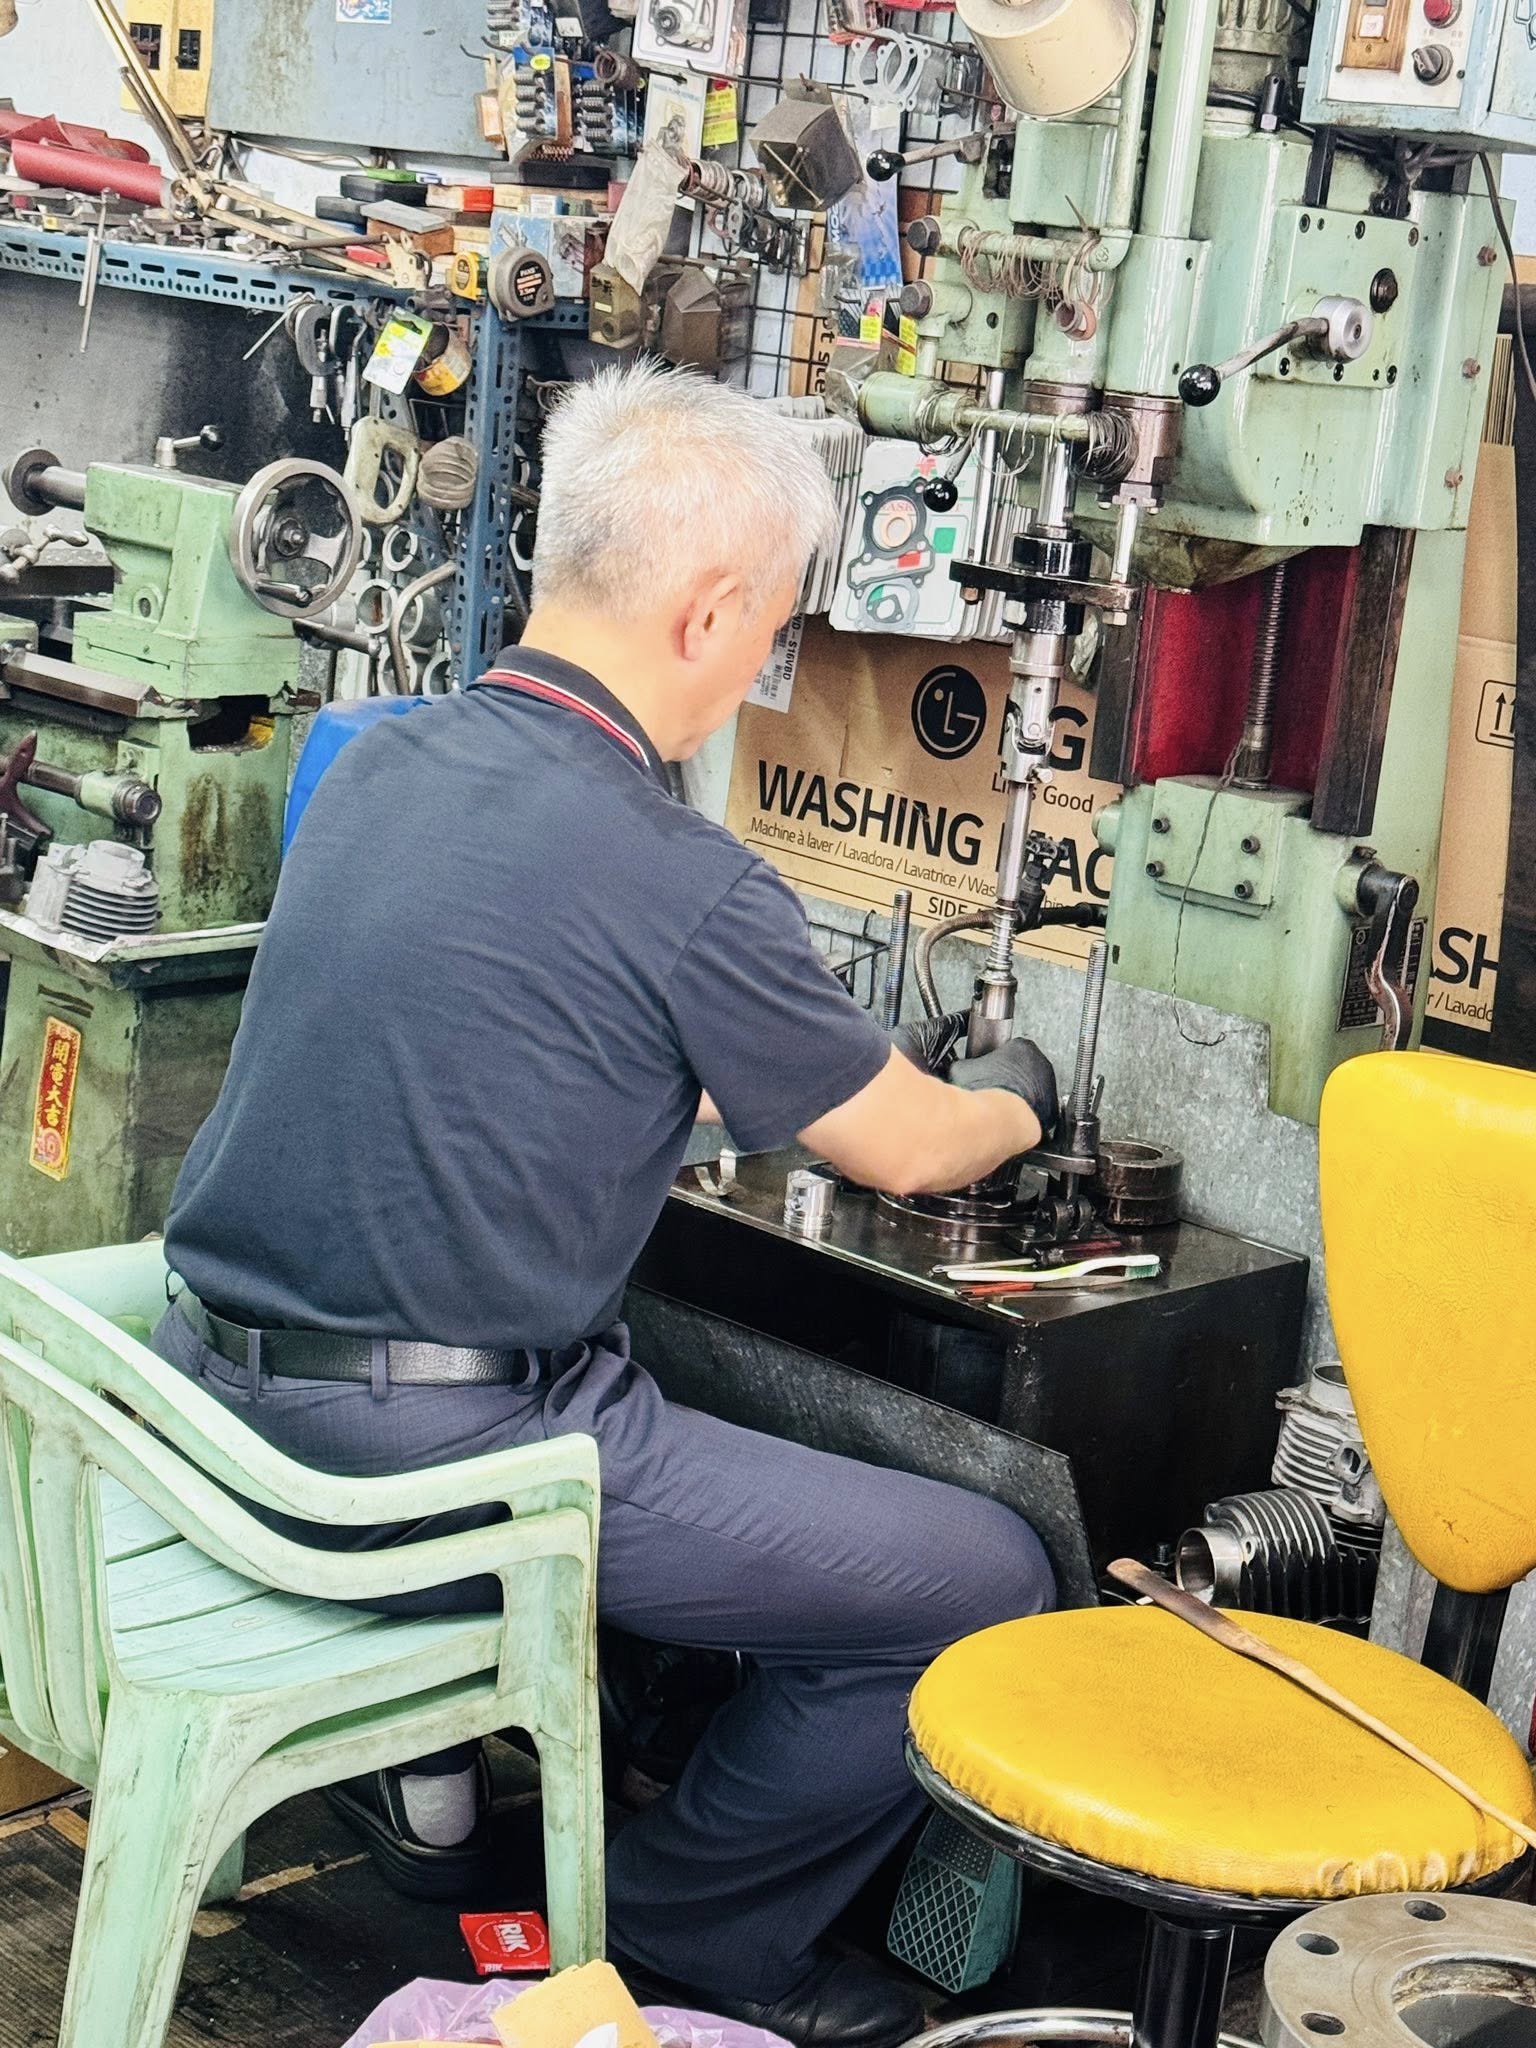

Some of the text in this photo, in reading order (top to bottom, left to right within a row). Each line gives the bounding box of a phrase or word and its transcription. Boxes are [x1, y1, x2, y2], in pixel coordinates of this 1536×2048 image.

[758, 760, 985, 866] WASHING
[1043, 785, 1094, 813] Good
[751, 817, 796, 843] Machine
[797, 831, 806, 846] à
[807, 832, 835, 855] laver
[843, 844, 894, 871] Lavadora
[903, 864, 957, 888] Lavatrice
[498, 1923, 531, 1953] RIK
